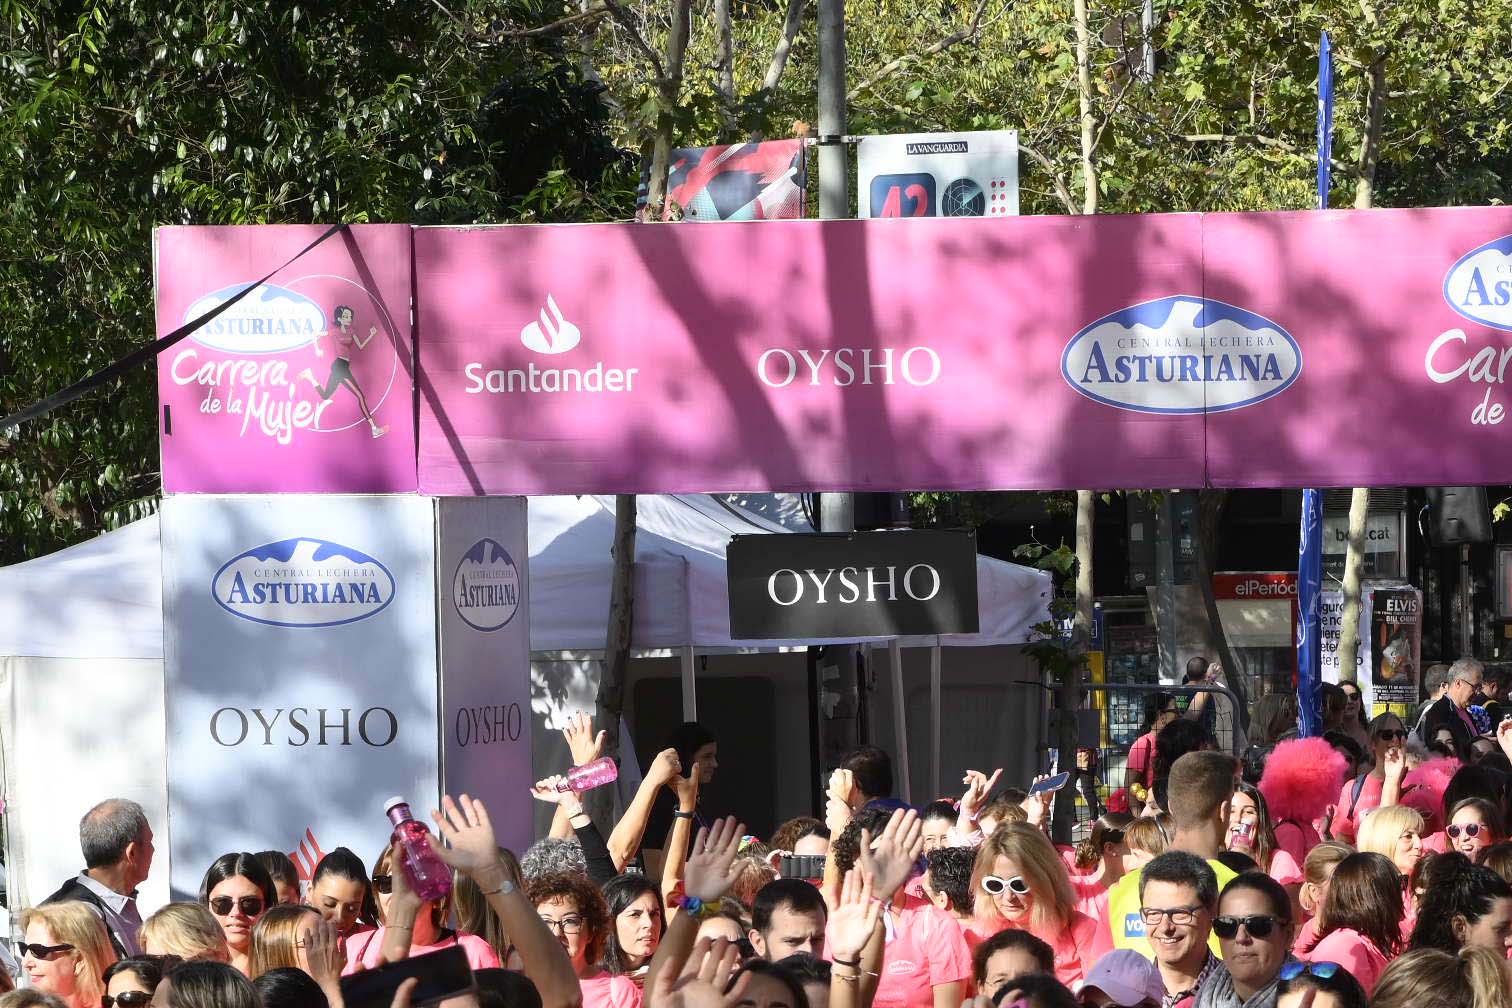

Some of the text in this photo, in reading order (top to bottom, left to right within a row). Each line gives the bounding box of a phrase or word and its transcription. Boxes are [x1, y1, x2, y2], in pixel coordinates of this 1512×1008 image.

[918, 143, 967, 153] VANGUARDIA
[1117, 336, 1275, 349] CENTRAL LECHERA
[171, 350, 288, 386] Carrera
[464, 361, 639, 394] Santander
[757, 346, 941, 388] OYSHO
[1081, 341, 1283, 383] ASTURIANA
[200, 384, 333, 444] de la Mujer
[1471, 387, 1504, 425] de
[227, 570, 382, 604] ASTURIANA
[254, 568, 375, 578] CENTRAL LECHERA
[458, 573, 517, 608] ASTURIANA
[767, 563, 941, 606] OYSHO
[1386, 600, 1416, 612] ELVIS
[209, 707, 398, 747] OYSHO
[455, 702, 522, 747] OYSHO
